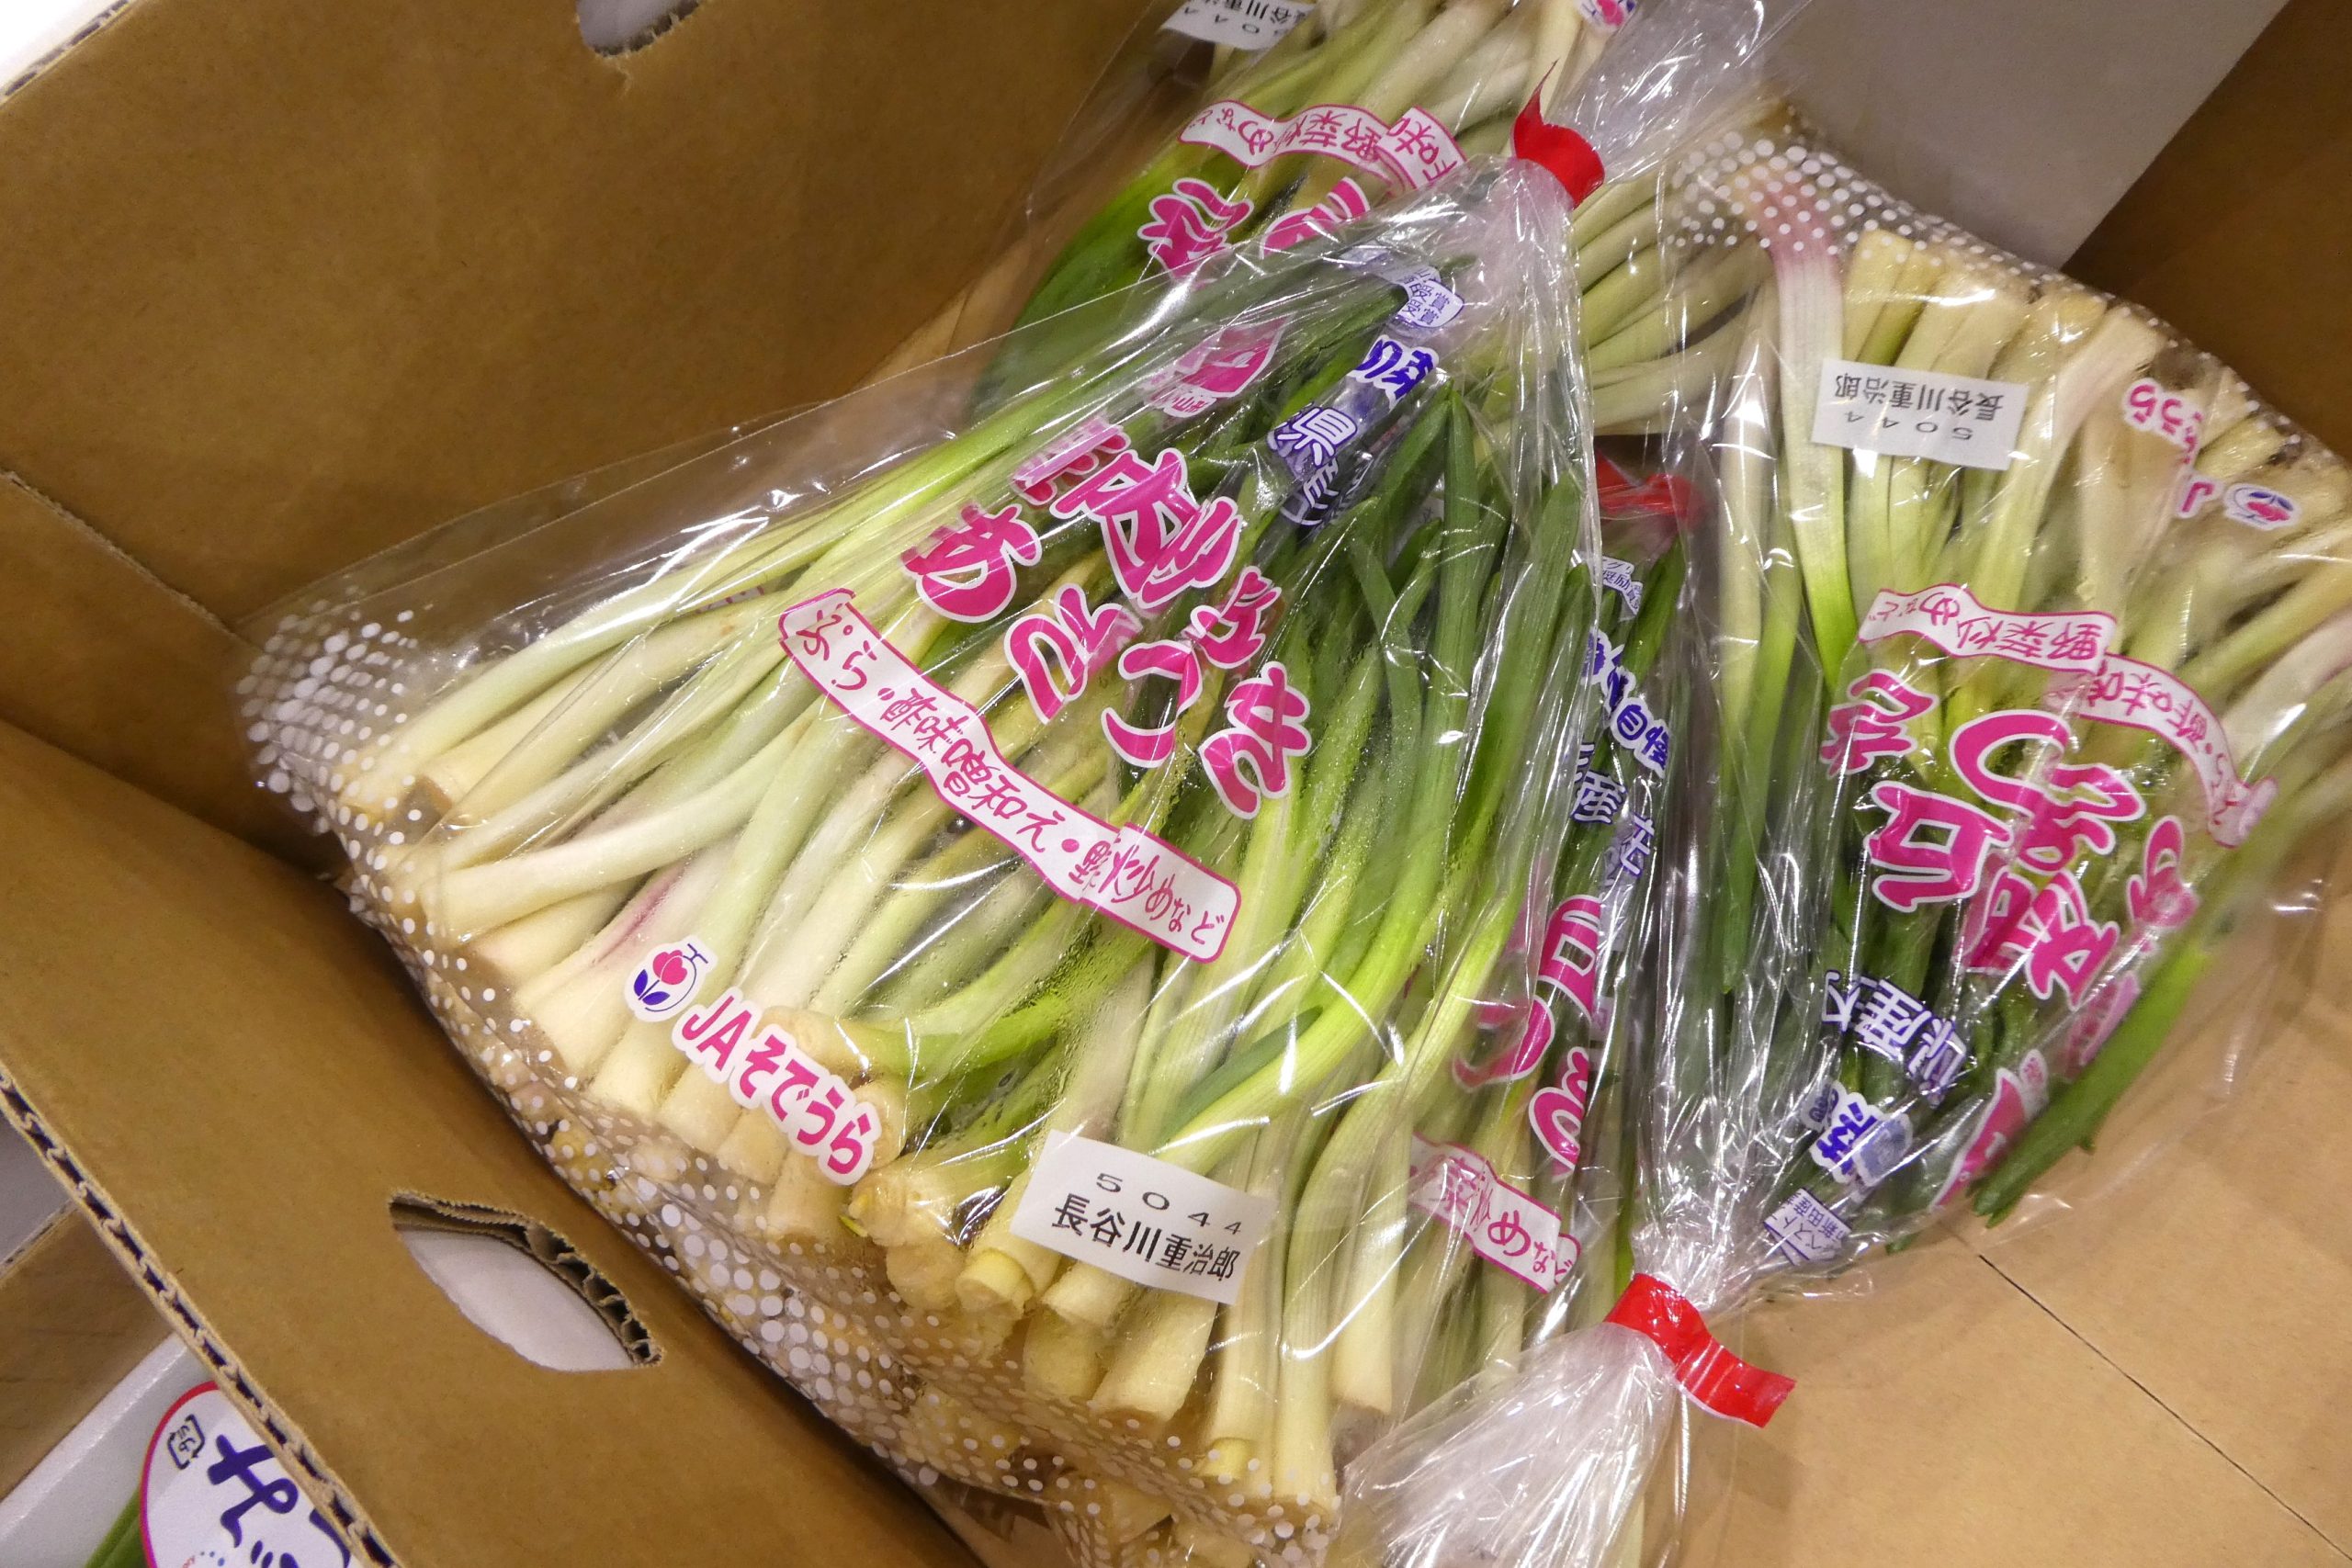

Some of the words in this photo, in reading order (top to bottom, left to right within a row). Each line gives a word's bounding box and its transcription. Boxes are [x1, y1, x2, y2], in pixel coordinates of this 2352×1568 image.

[1834, 372, 2005, 422] 長谷川重治郎
[901, 502, 1314, 820] あさつき
[680, 994, 876, 1177] JAそでうら
[1052, 1193, 1239, 1282] 長谷川重治郎
[1095, 1172, 1243, 1235] 5044
